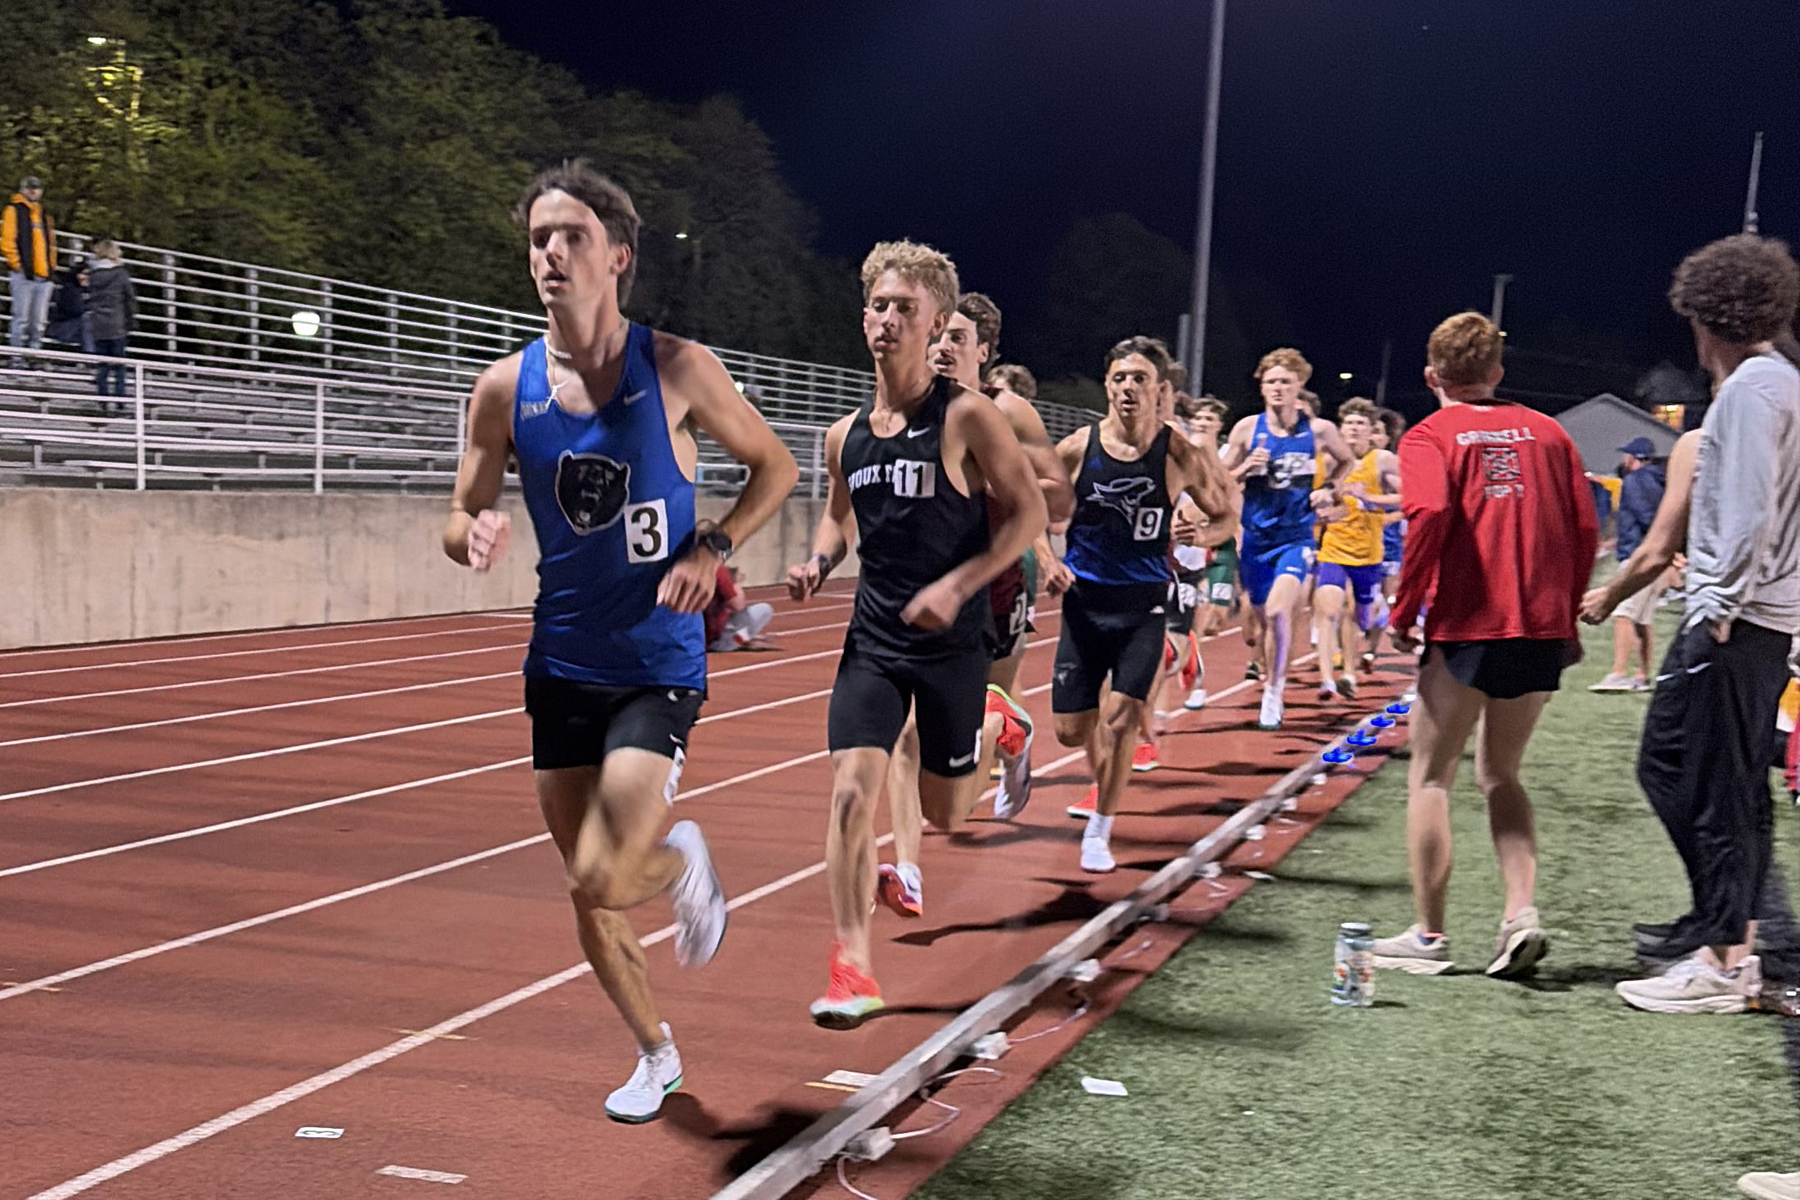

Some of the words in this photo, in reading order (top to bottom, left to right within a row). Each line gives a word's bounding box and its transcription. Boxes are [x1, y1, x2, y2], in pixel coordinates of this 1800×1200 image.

[898, 463, 924, 495] 11
[631, 507, 662, 557] 3
[1139, 510, 1158, 537] 9
